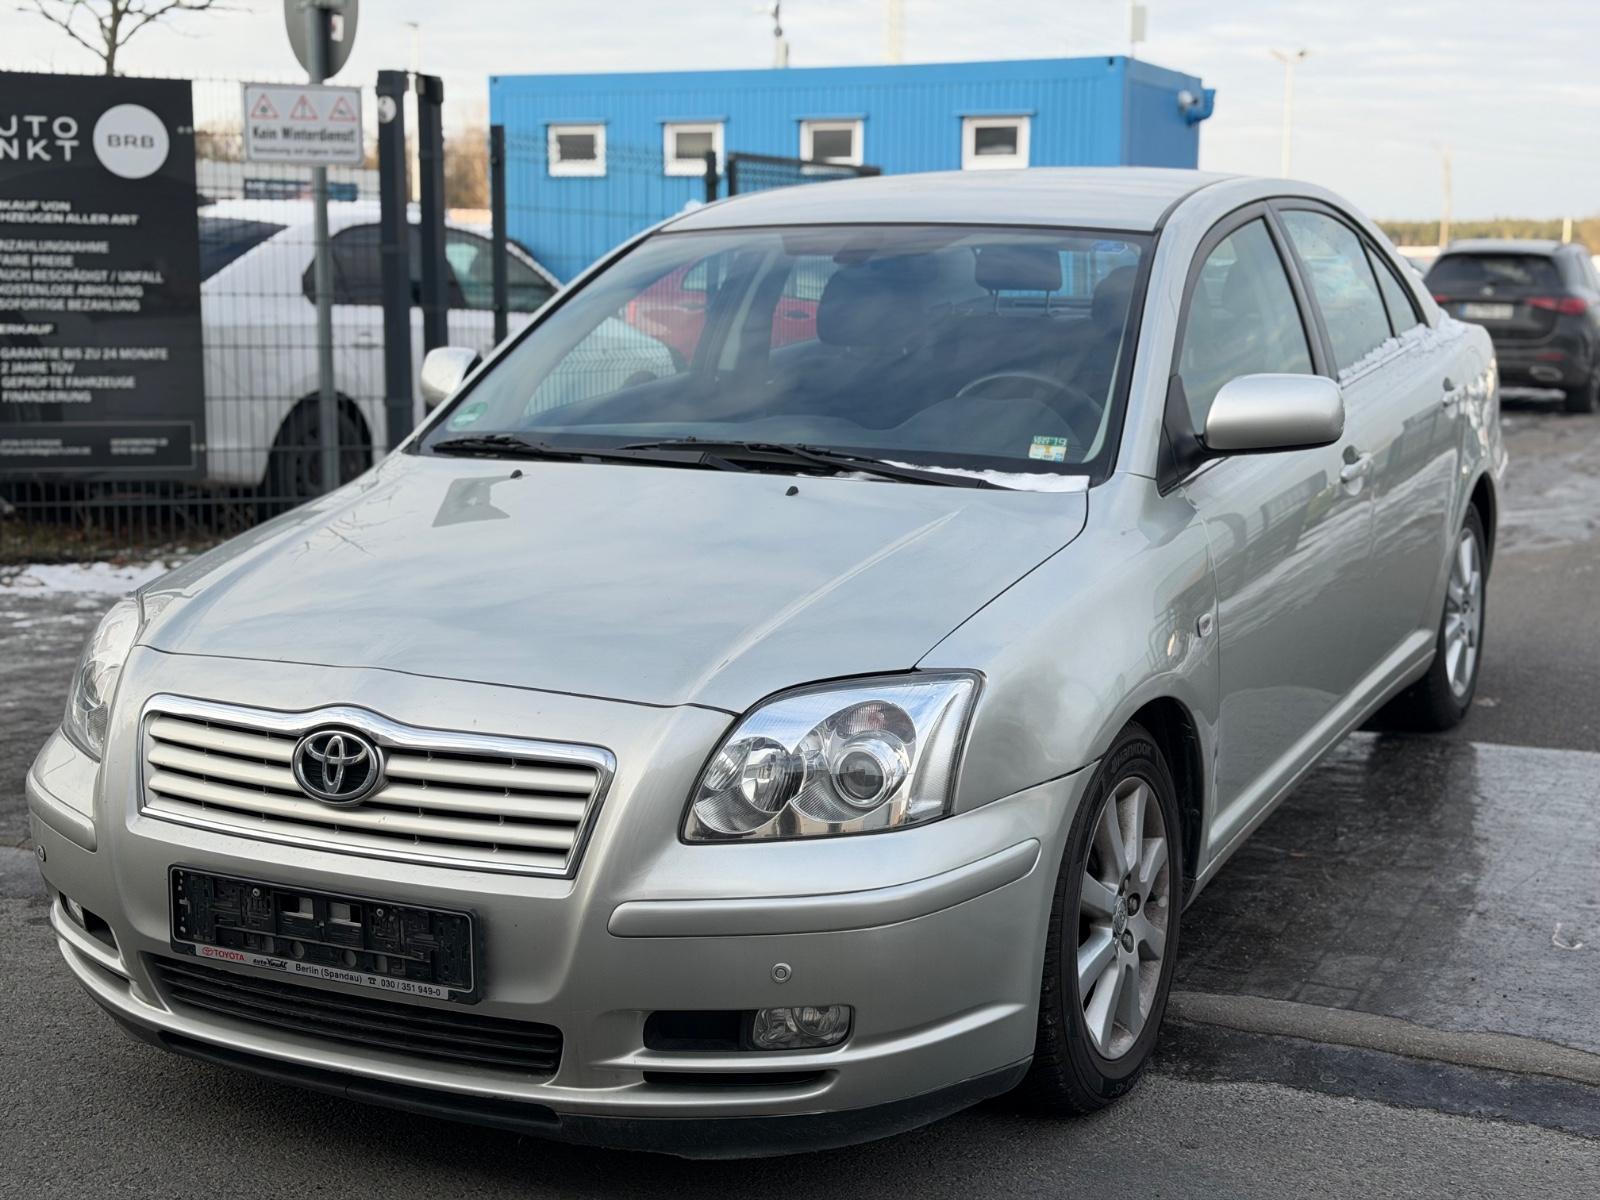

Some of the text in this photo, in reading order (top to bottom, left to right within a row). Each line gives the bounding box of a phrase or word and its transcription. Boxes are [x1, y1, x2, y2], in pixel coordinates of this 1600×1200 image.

[107, 134, 155, 148] BRB
[40, 200, 71, 212] VON
[65, 213, 109, 225] ALLER
[110, 214, 139, 226] ART
[31, 254, 74, 268] PREISE
[32, 268, 108, 283] BESCHÄDIGT
[117, 270, 164, 284] UNFALL
[76, 284, 144, 298] ABHOLUNG
[66, 298, 141, 312] BEZAHLUNG
[0, 347, 168, 360] GARANTIE BIS ZU 24 MONATE
[0, 360, 76, 374] 2 JAHRE TÜV
[65, 375, 136, 389] FAHRZEUGE
[2, 390, 92, 403] FINANZIERUNG
[214, 949, 245, 961] TOYOTA
[295, 963, 319, 975] Berlin
[321, 968, 363, 984] (Spandau)
[380, 979, 396, 988] 030
[401, 982, 416, 992] 351
[418, 985, 441, 996] 949-0
